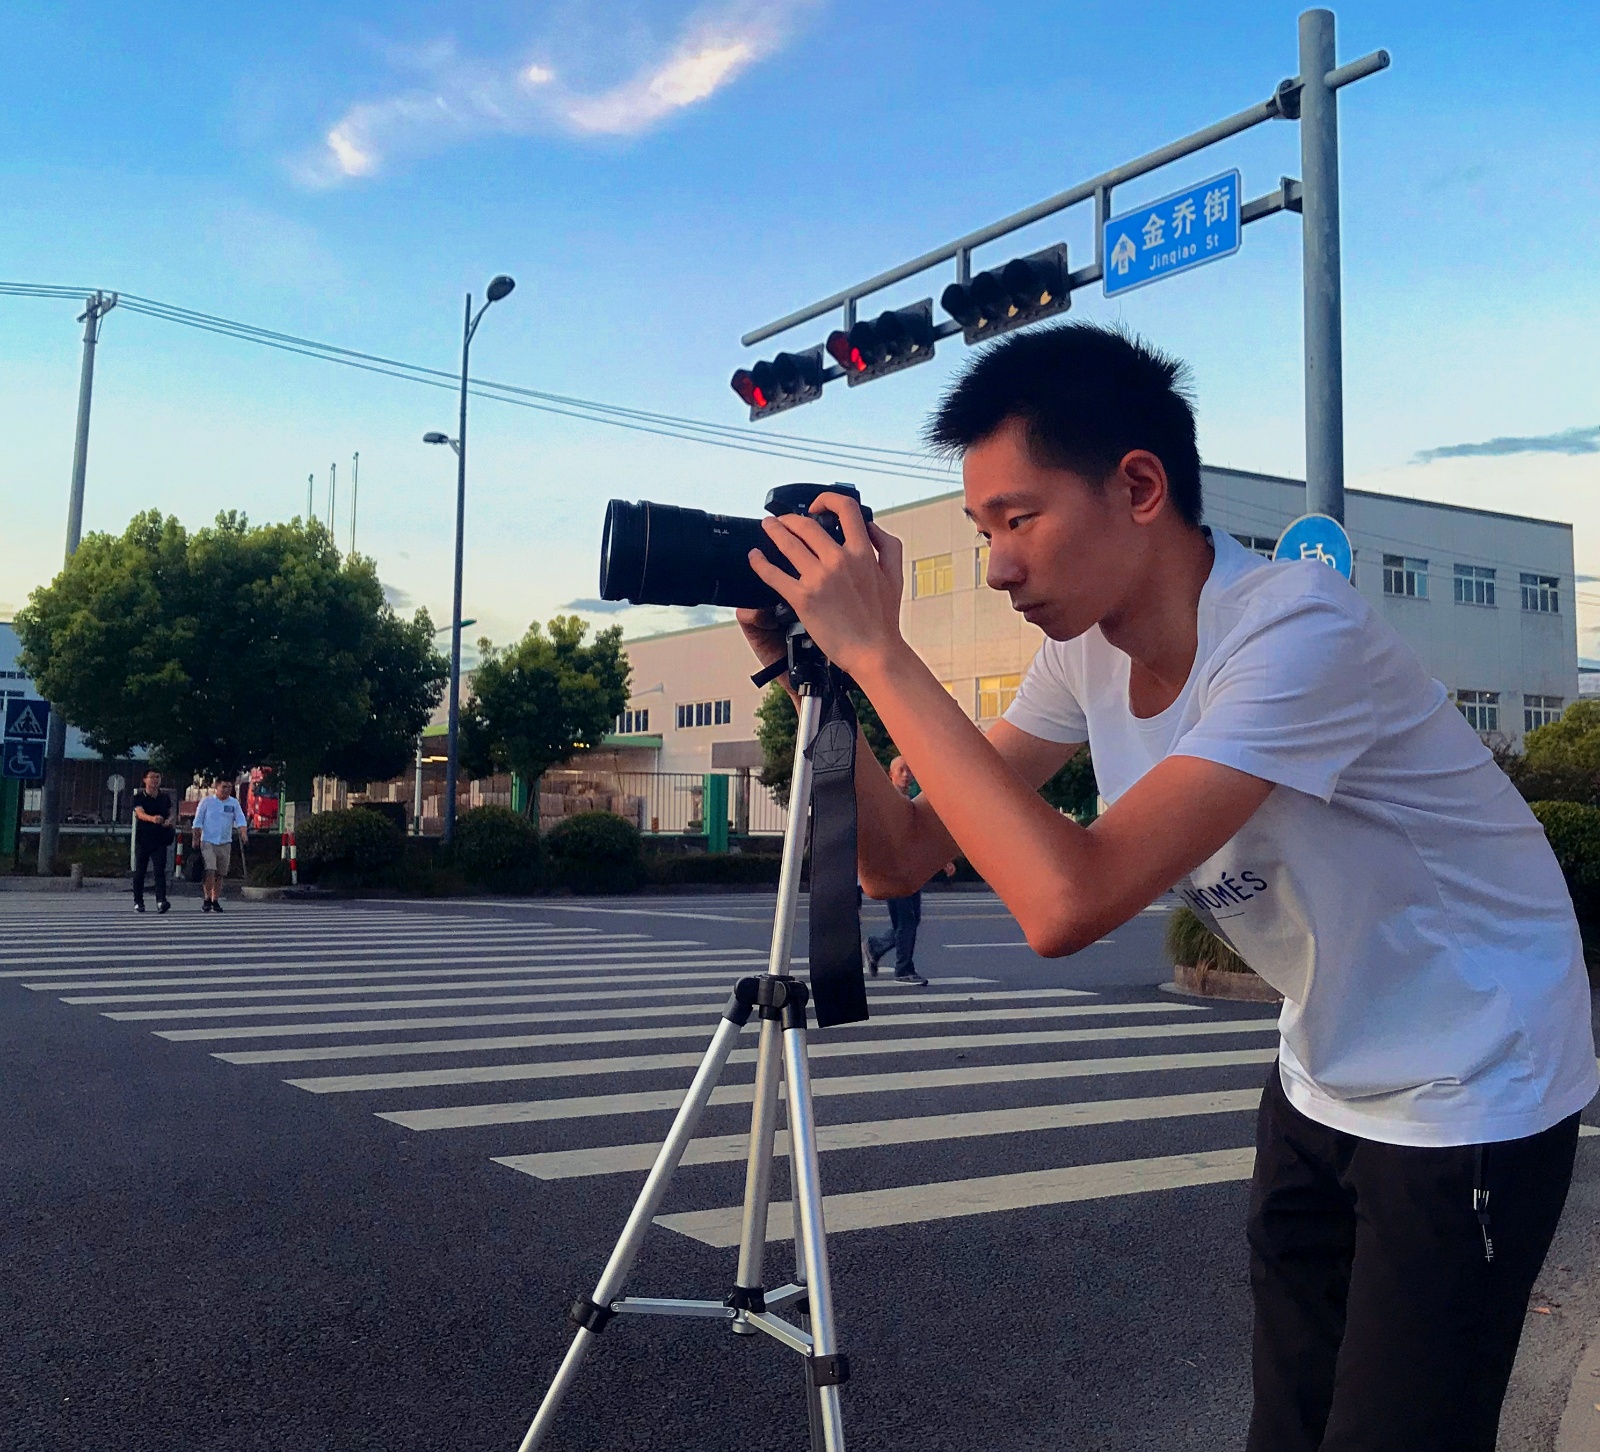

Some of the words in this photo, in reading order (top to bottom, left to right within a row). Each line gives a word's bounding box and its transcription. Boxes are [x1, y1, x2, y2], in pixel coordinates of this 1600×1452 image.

[1141, 185, 1230, 251] 金乔街
[1149, 243, 1197, 271] Jinqiao
[1206, 233, 1219, 250] St
